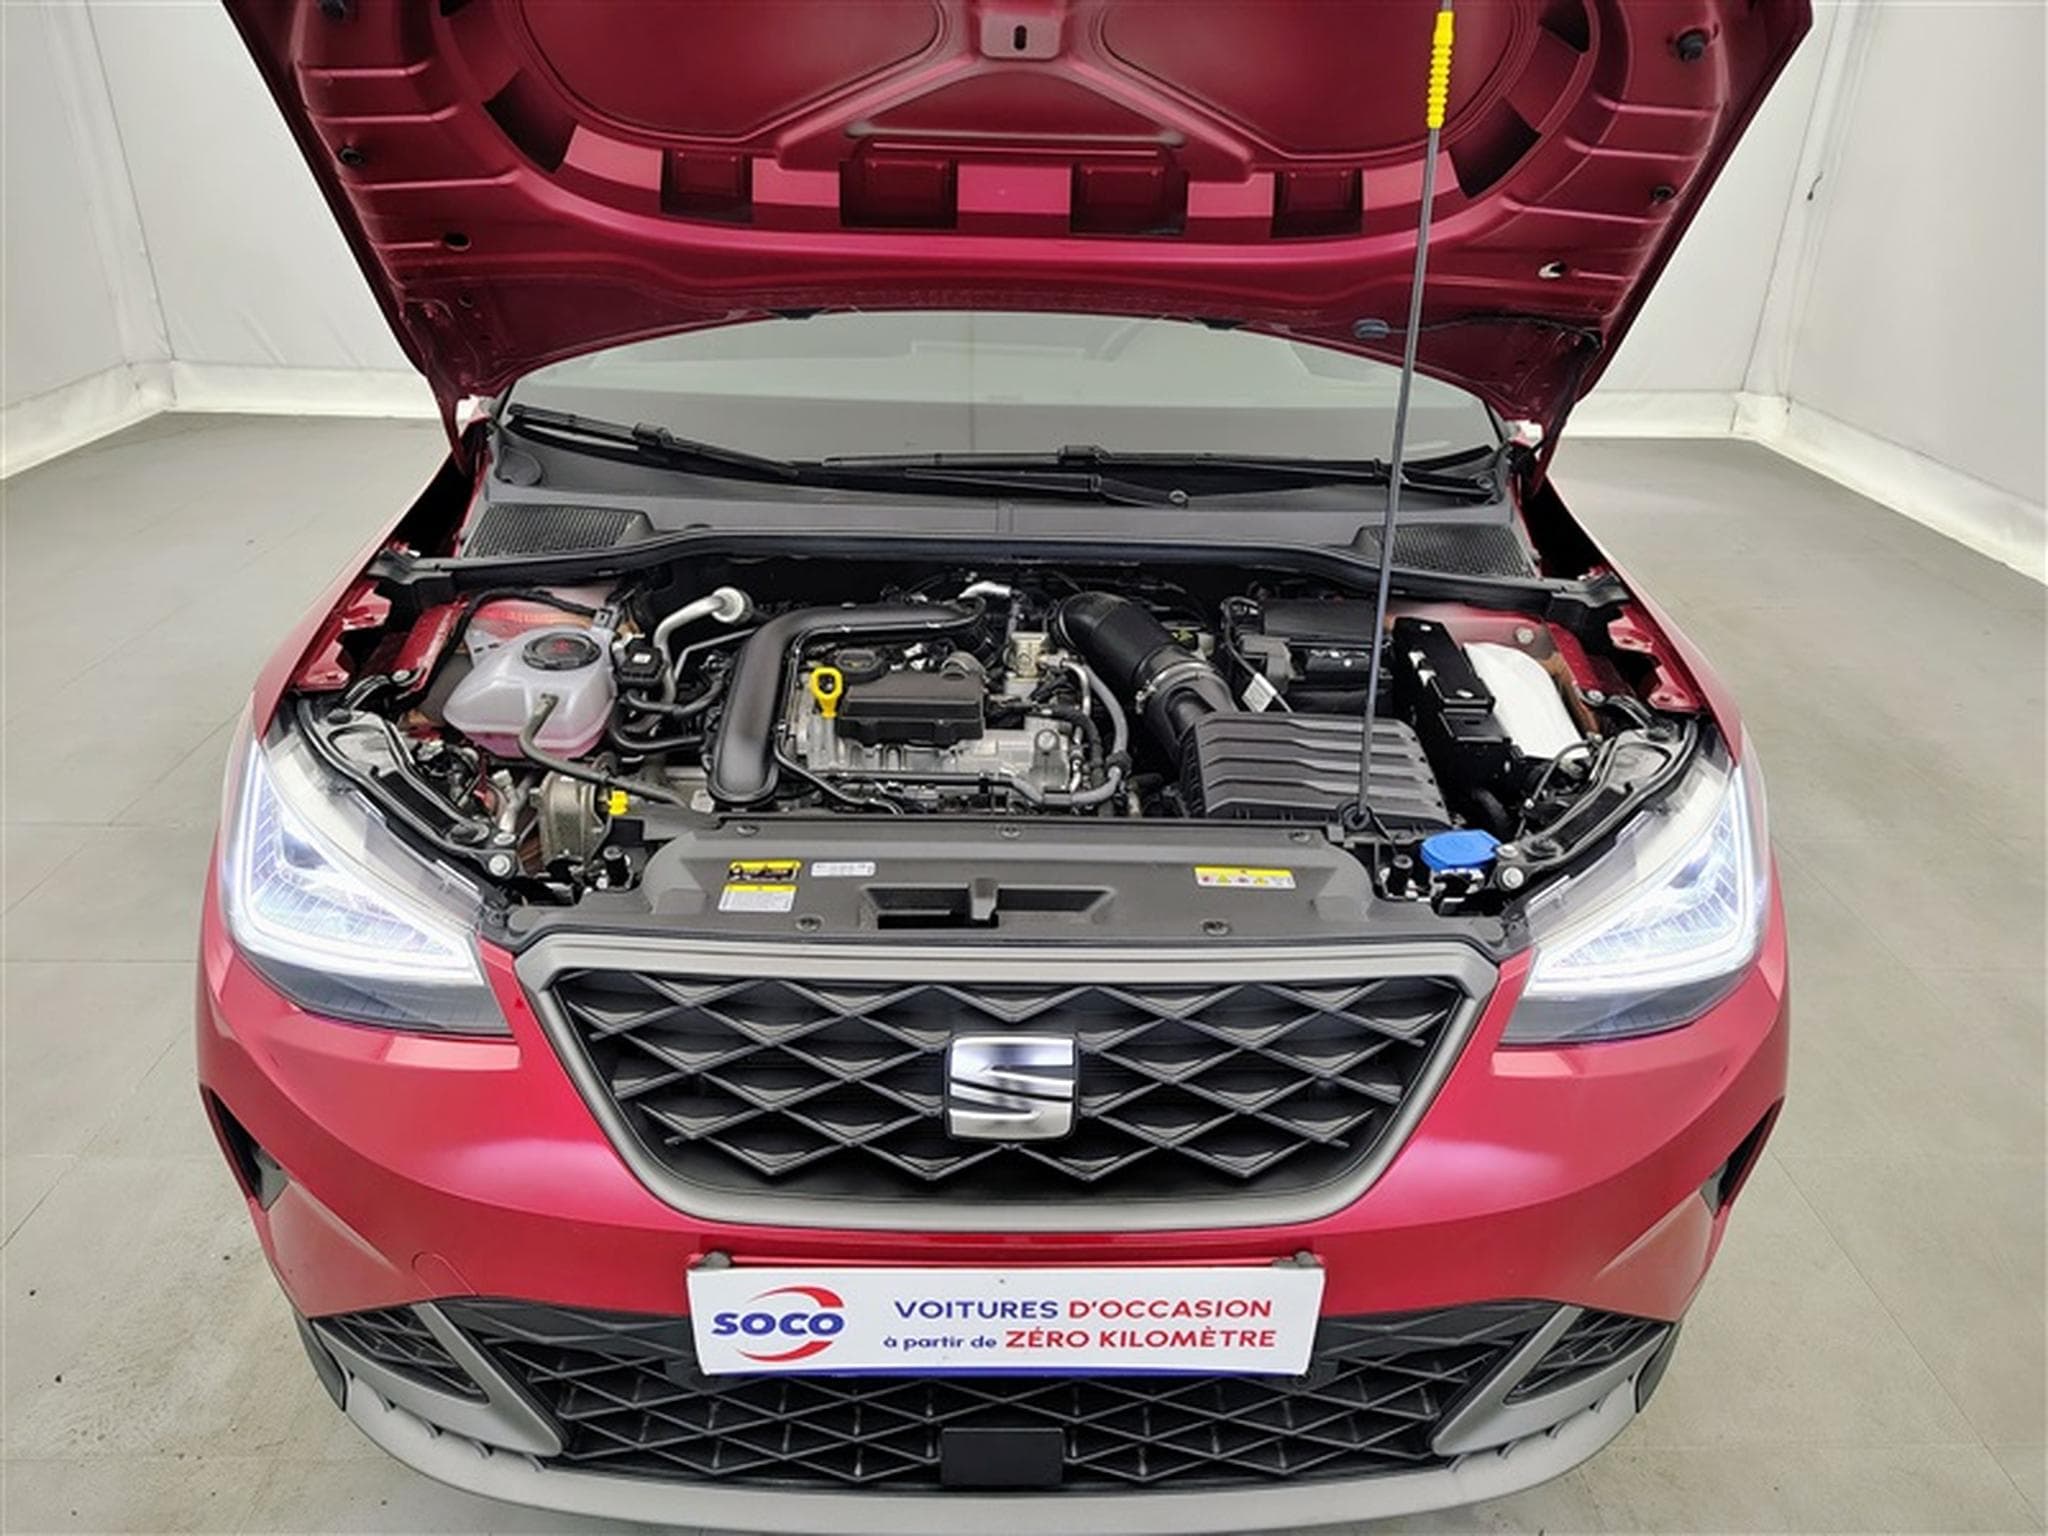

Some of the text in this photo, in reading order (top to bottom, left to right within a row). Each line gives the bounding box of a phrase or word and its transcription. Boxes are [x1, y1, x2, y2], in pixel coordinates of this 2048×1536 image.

[894, 1299, 1272, 1320] VOITURES D'OCCASION
[711, 1311, 845, 1336] SOCO
[883, 1325, 1277, 1352] à partir de ZÉRO KILOMÈTRE
